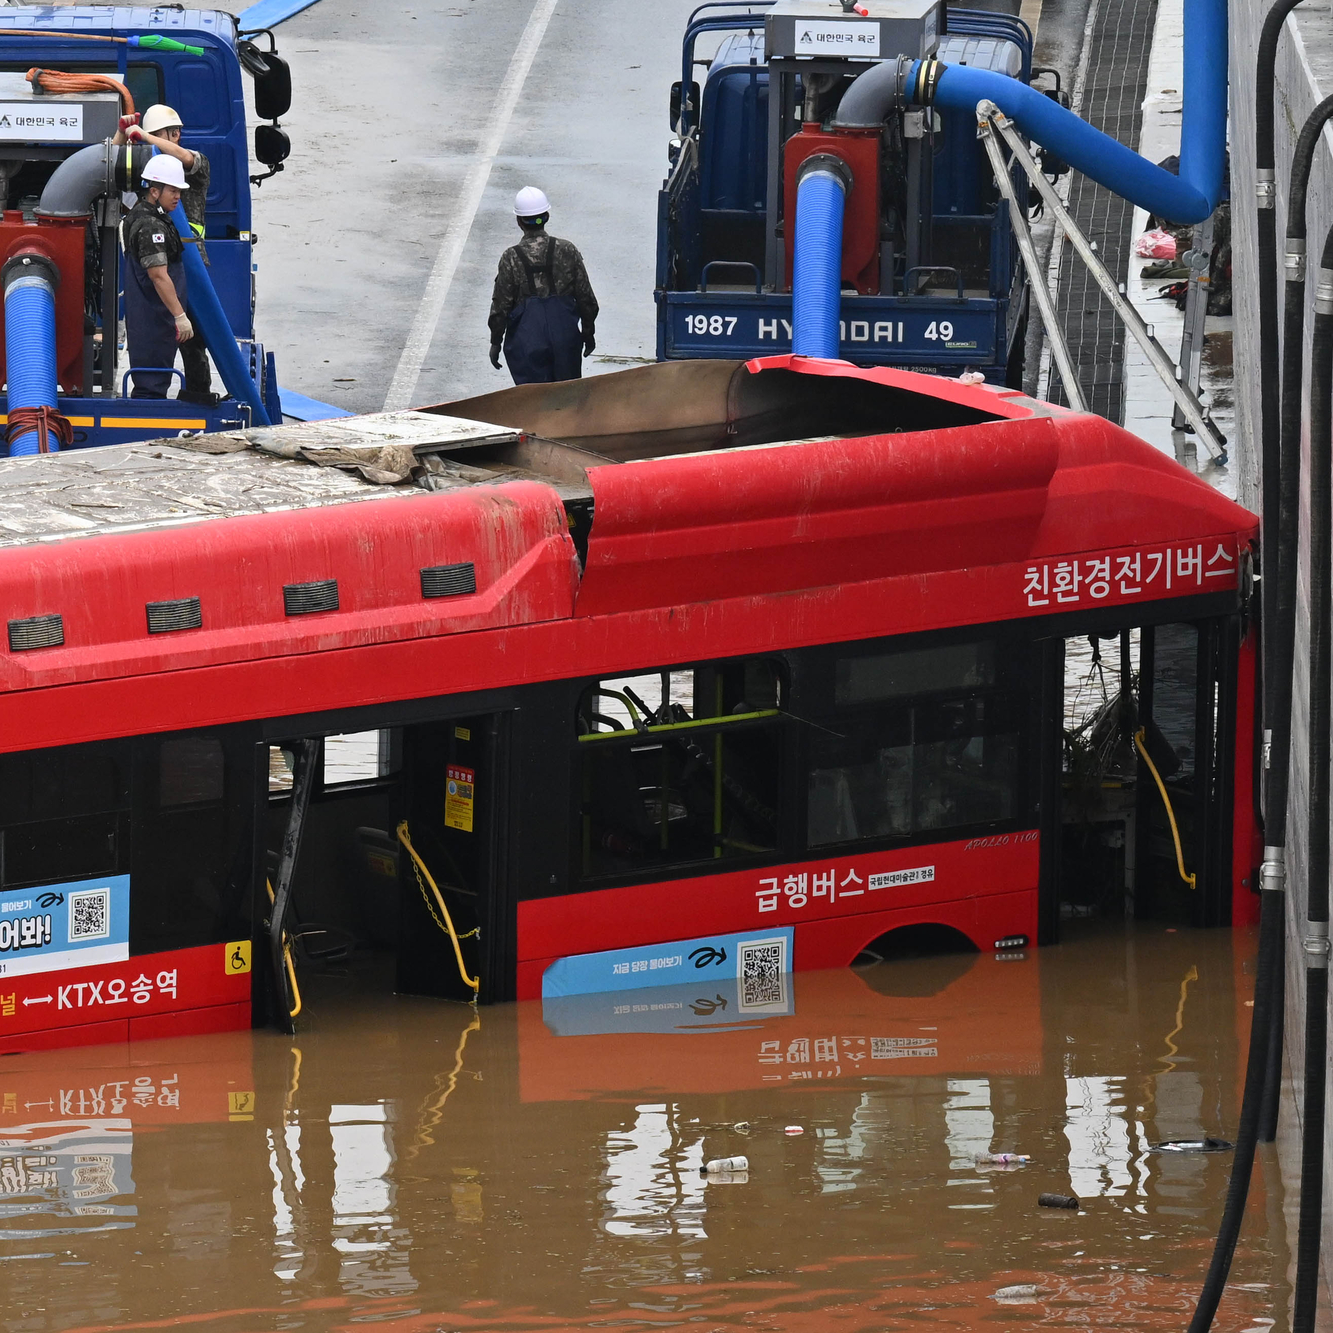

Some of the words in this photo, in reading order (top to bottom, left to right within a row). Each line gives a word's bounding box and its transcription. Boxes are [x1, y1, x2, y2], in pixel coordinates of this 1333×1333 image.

[816, 33, 854, 44] 대한민국
[857, 34, 876, 44] 육군
[15, 116, 55, 127] 대한민국
[59, 116, 78, 127] 육군
[685, 314, 738, 337] 1987
[924, 321, 954, 341] 49
[1023, 543, 1236, 607] 친환경전기버스
[964, 835, 1009, 852] APOLLO
[1014, 831, 1038, 844] 1100
[921, 868, 934, 879] 경유
[755, 868, 865, 913] 급행버스
[1, 899, 32, 914] 물어보기
[612, 963, 630, 975] 지금
[631, 961, 648, 973] 당장
[649, 955, 683, 972] 물어보기
[57, 968, 178, 1010] KTX오송역
